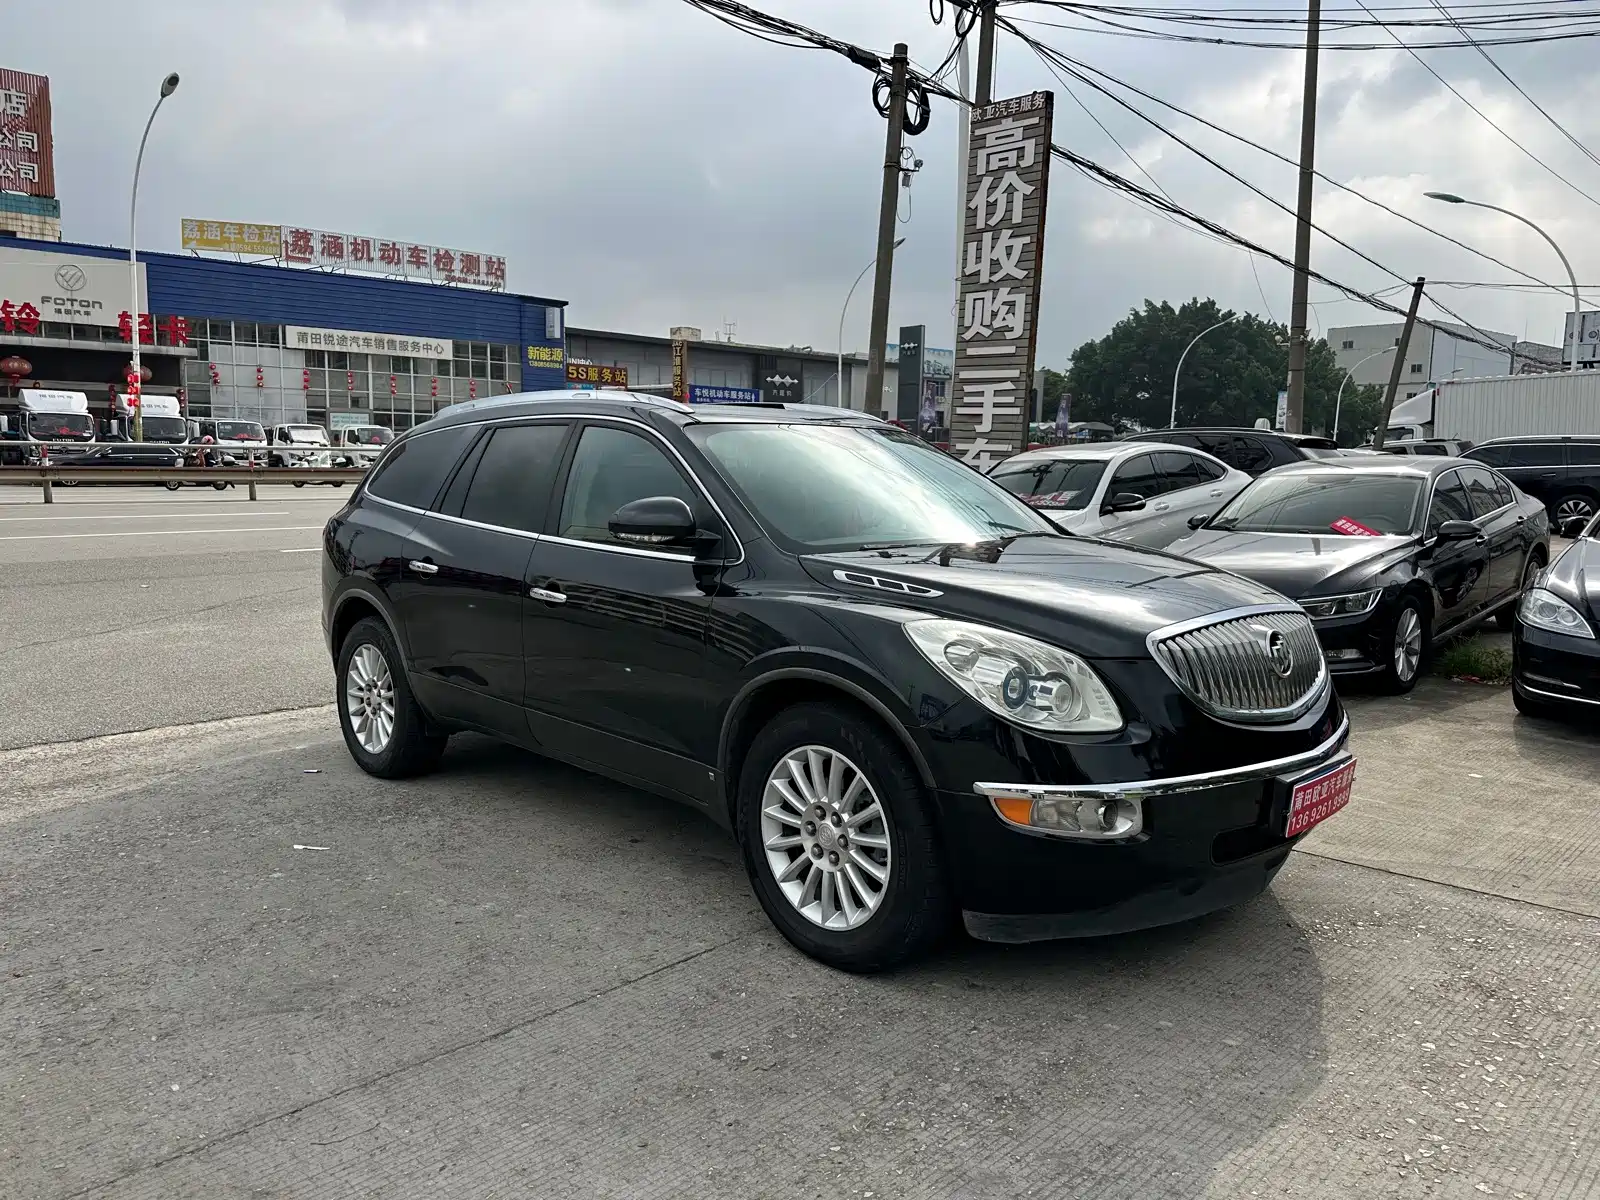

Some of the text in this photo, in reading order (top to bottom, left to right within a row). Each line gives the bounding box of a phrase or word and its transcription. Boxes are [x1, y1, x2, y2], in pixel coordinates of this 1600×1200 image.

[970, 93, 1045, 121] 欧亚汽车服务
[183, 220, 280, 244] 荔涵年检站
[289, 228, 505, 281] 荔涵机动车检测站
[41, 296, 103, 309] FOTON
[955, 116, 1041, 474] 高价收购二手车
[54, 308, 92, 317] 福田汽车
[296, 331, 445, 355] 莆田锐途汽车销售服务中心
[527, 345, 563, 361] 新能源
[568, 365, 627, 383] 5S服务站
[694, 387, 751, 400] 车悦机动车服务站
[1291, 810, 1310, 831] 136
[1310, 800, 1332, 822] 9261
